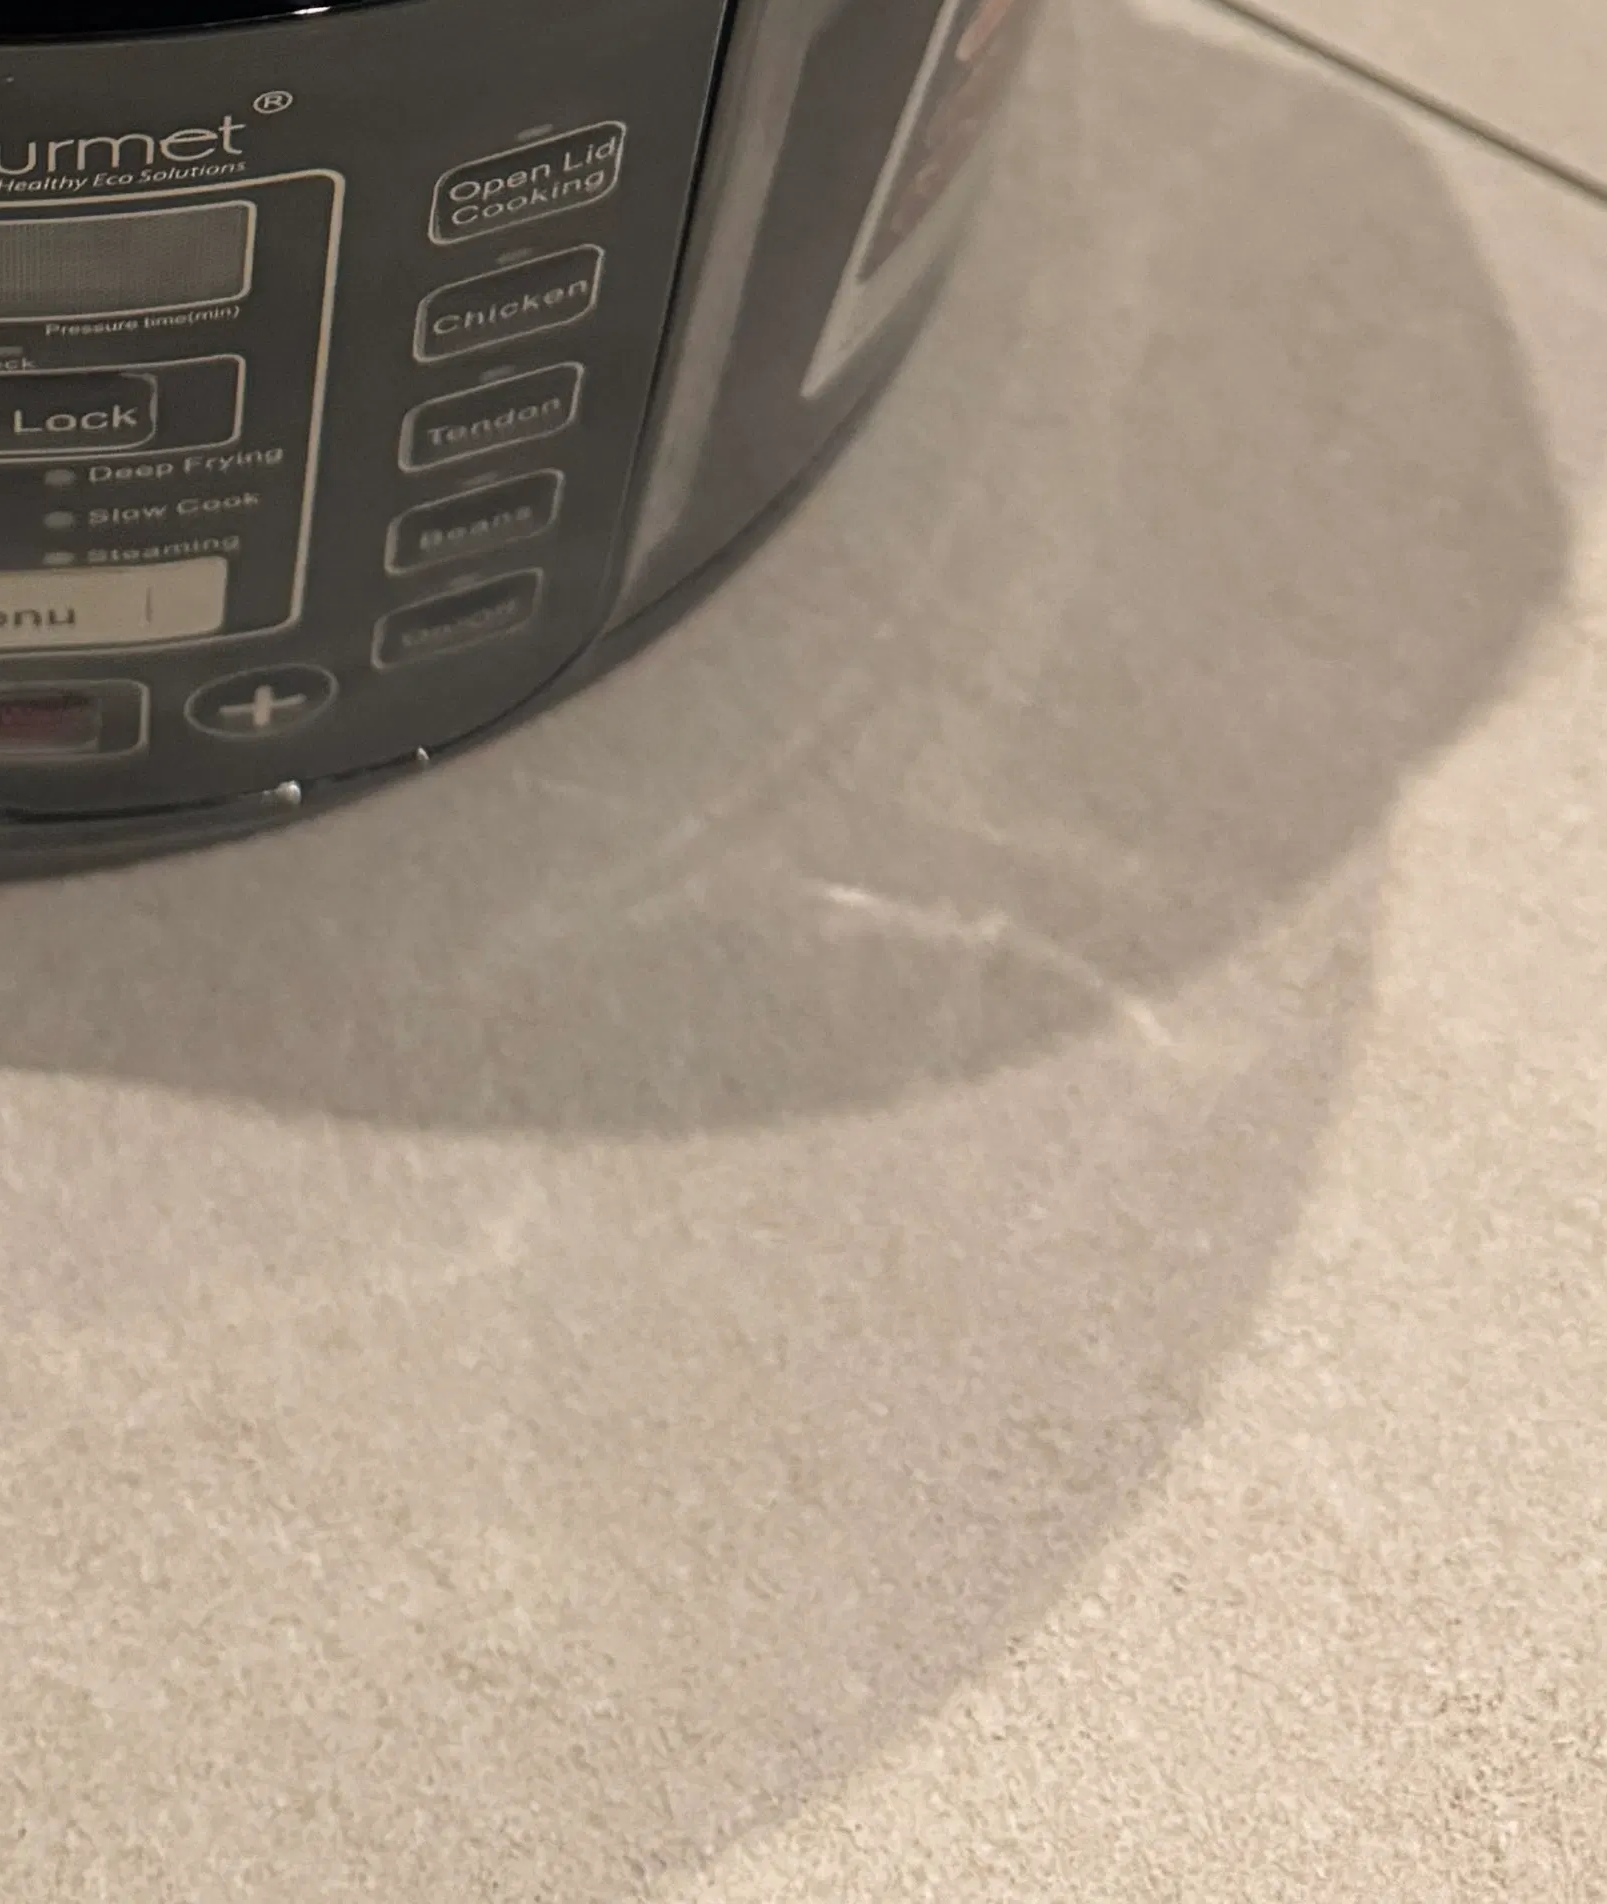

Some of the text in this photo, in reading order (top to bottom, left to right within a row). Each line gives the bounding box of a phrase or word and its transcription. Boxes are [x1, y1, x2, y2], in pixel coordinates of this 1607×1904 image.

[93, 167, 136, 188] Eco
[139, 158, 247, 186] Solutions
[449, 136, 617, 203] Open Lid
[451, 169, 604, 226] Cooking
[44, 304, 242, 339] Pressure time(min)
[432, 279, 588, 335] Chicken
[12, 404, 140, 434] Lock
[88, 445, 285, 484] Deep Frying
[88, 491, 262, 527] Slow Cook
